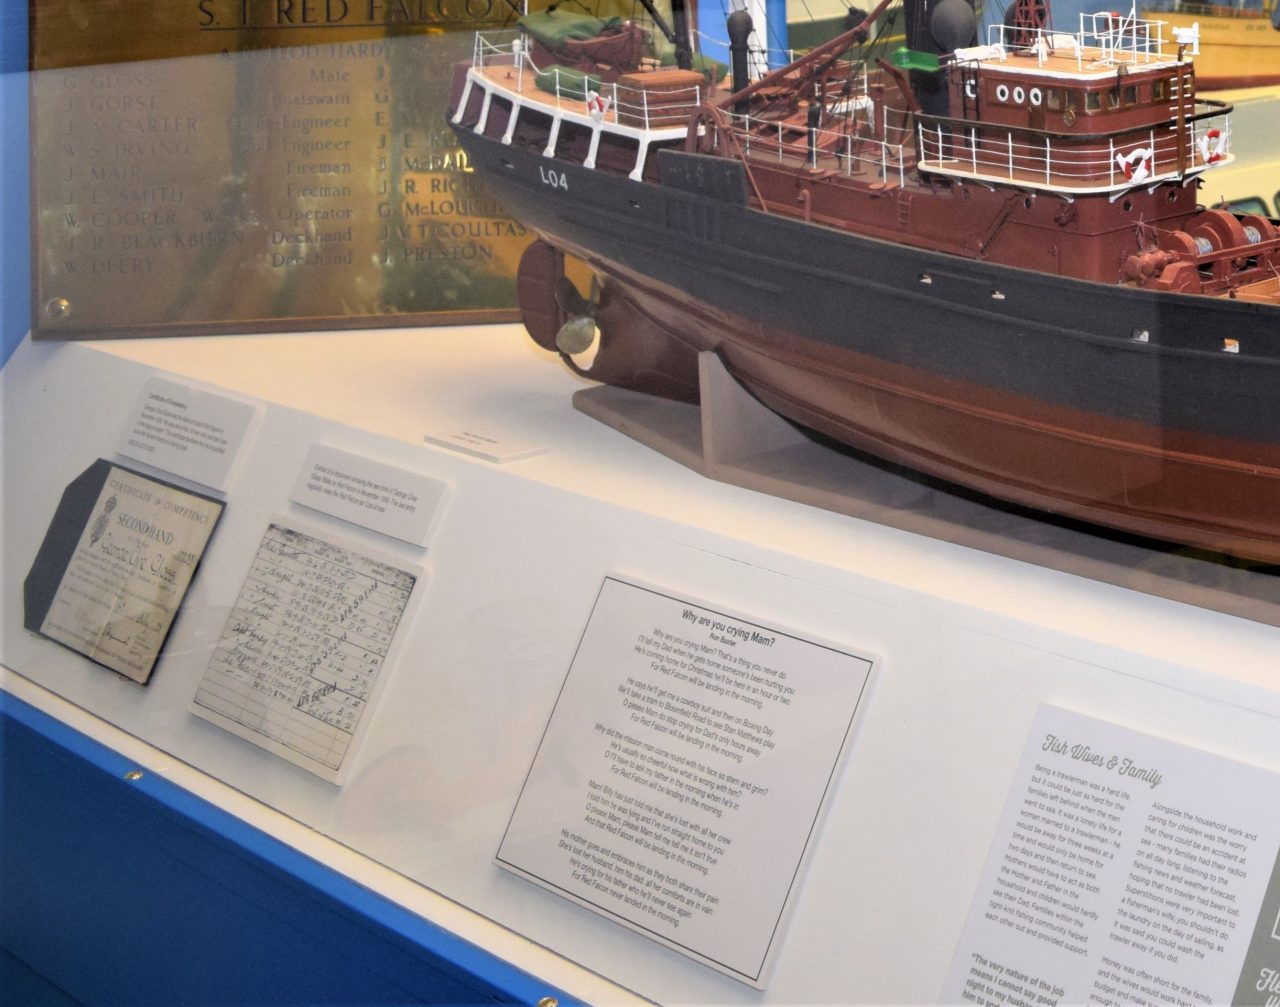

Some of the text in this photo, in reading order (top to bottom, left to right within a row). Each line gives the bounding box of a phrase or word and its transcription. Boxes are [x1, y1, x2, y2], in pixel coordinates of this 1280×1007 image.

[310, 70, 350, 83] Mate
[283, 114, 351, 132] Engineer
[283, 138, 351, 156] Engineer
[540, 166, 568, 190] LO4
[277, 206, 353, 224] Operator
[272, 230, 352, 246] Deckhand
[436, 221, 528, 238] COULTAS
[272, 252, 352, 268] Deckhand
[403, 246, 493, 263] PRESTON
[682, 609, 776, 647] Why are you crying Mam?
[1042, 734, 1163, 789] Fish Wives & Family
[1152, 802, 1257, 841] Alongside the household work and
[1148, 814, 1248, 852] caring for children was the worry
[989, 960, 1005, 972] very
[1006, 968, 1029, 982] nature
[1030, 977, 1039, 986] of
[1039, 980, 1051, 991] the
[1051, 984, 1065, 997] job
